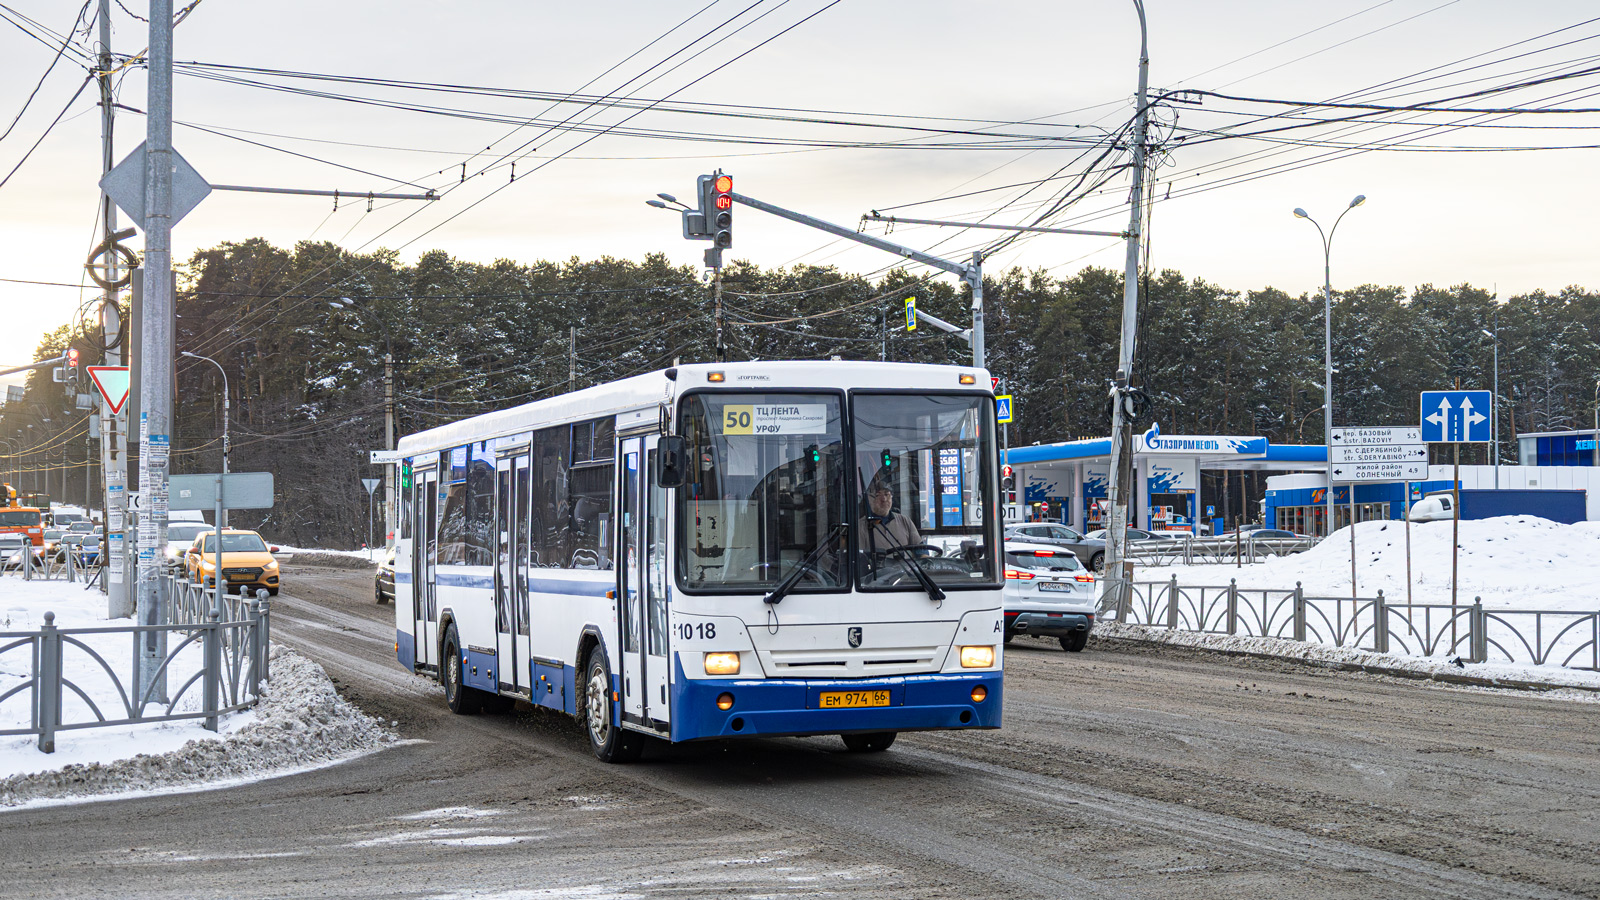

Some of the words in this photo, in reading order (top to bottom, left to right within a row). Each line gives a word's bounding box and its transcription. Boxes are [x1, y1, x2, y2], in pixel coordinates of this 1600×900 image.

[717, 198, 731, 208] 104
[756, 408, 769, 416] ТЦ
[770, 407, 800, 415] ЛЕНТА
[726, 412, 750, 428] 50
[1160, 439, 1219, 450] ГАЗПРОМНЕФТЬ
[678, 622, 716, 640] 1018
[826, 696, 840, 705] ЕМ
[846, 692, 868, 705] 974
[874, 692, 886, 700] 66
